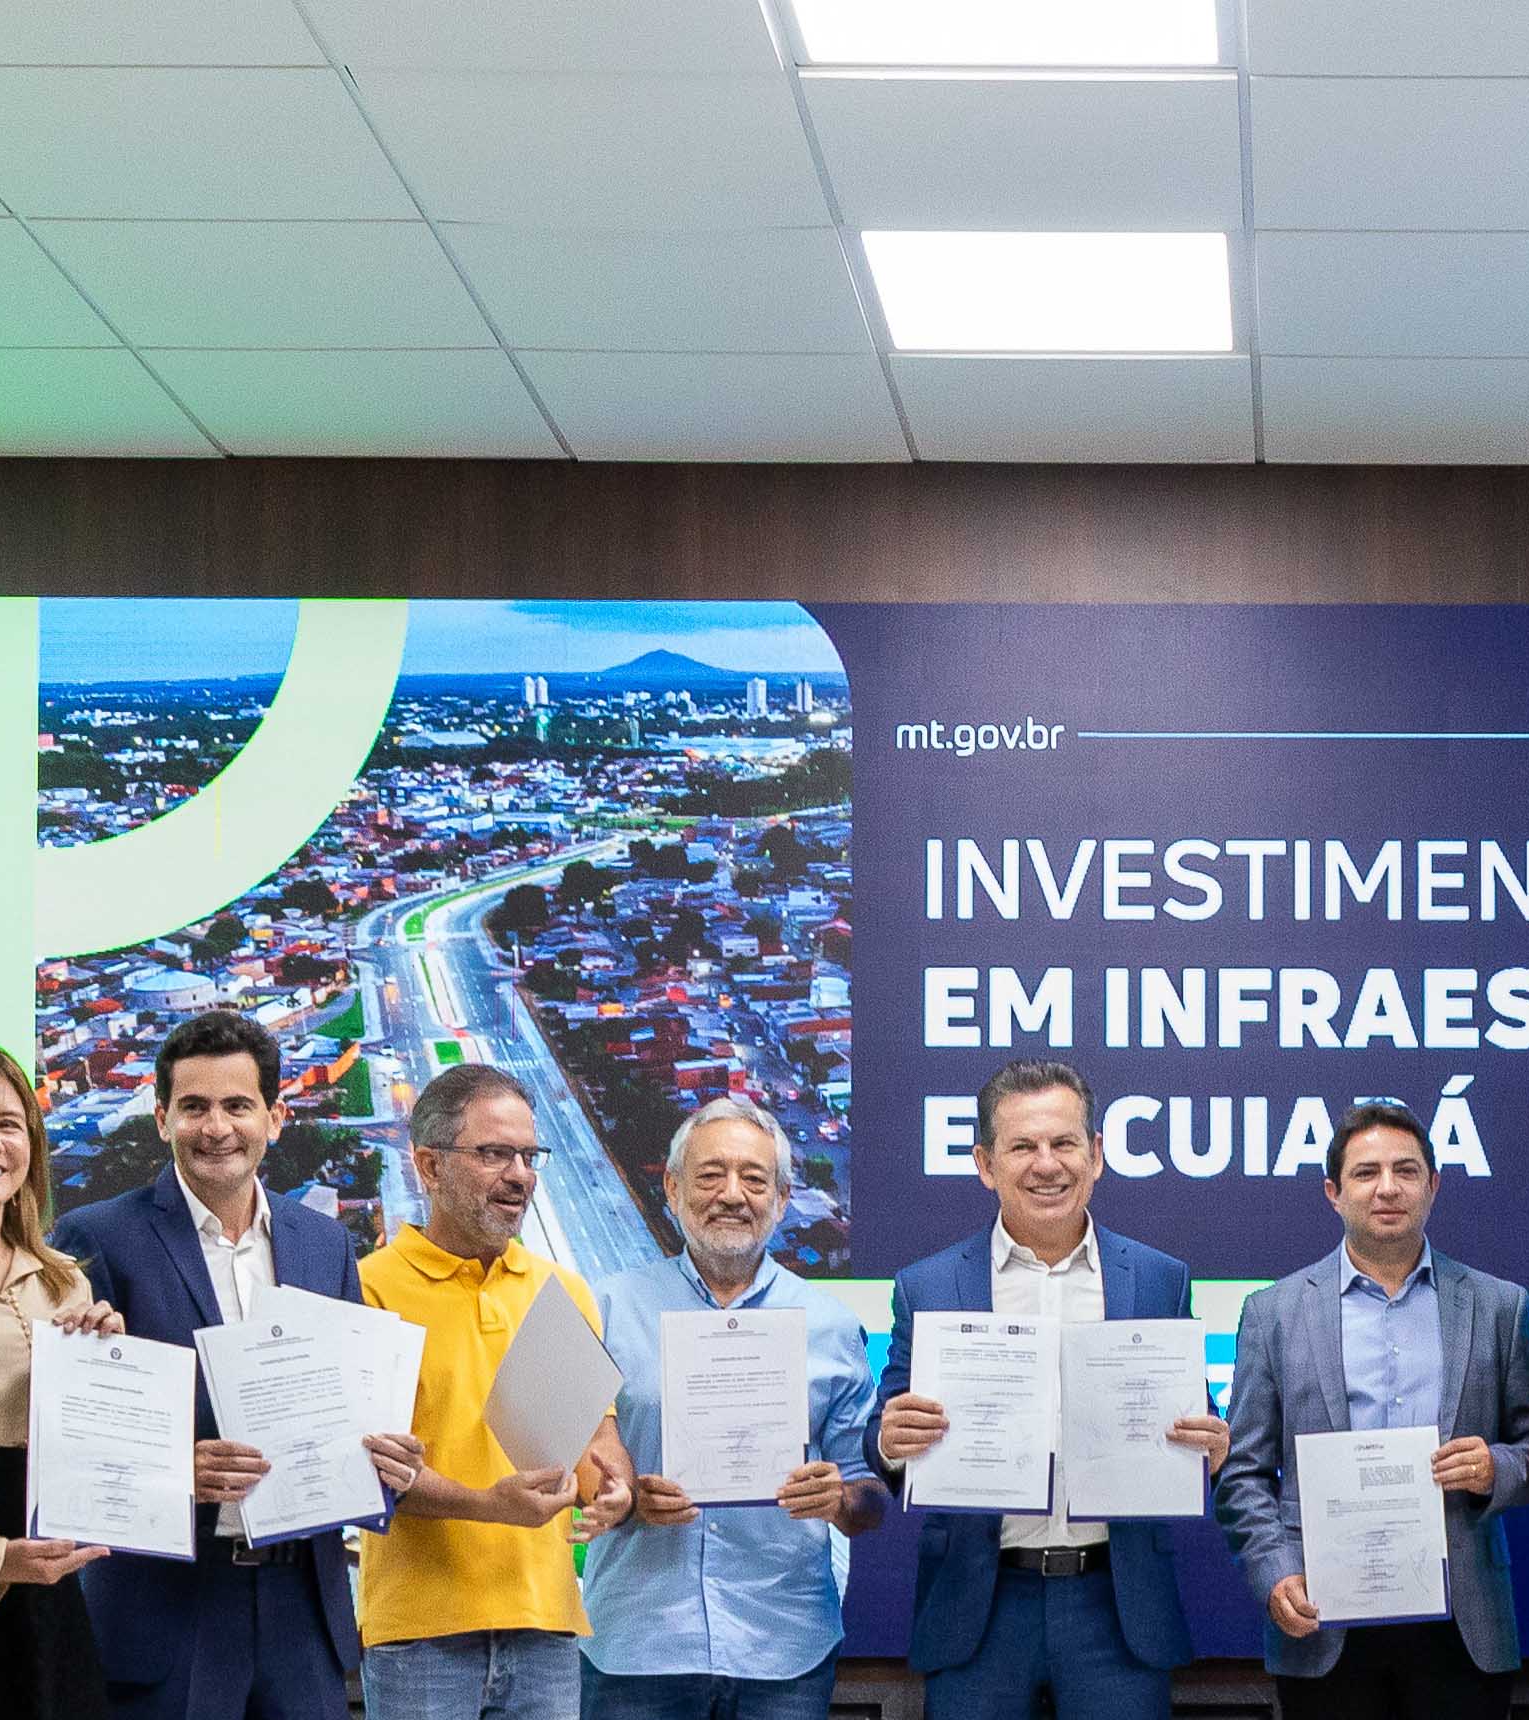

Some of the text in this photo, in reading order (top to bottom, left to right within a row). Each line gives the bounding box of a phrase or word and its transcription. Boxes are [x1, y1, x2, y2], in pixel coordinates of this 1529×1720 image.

[896, 716, 1067, 758] mt.gov.br
[924, 968, 1075, 1049] EM
[1102, 1074, 1493, 1179] CUIAÁ
